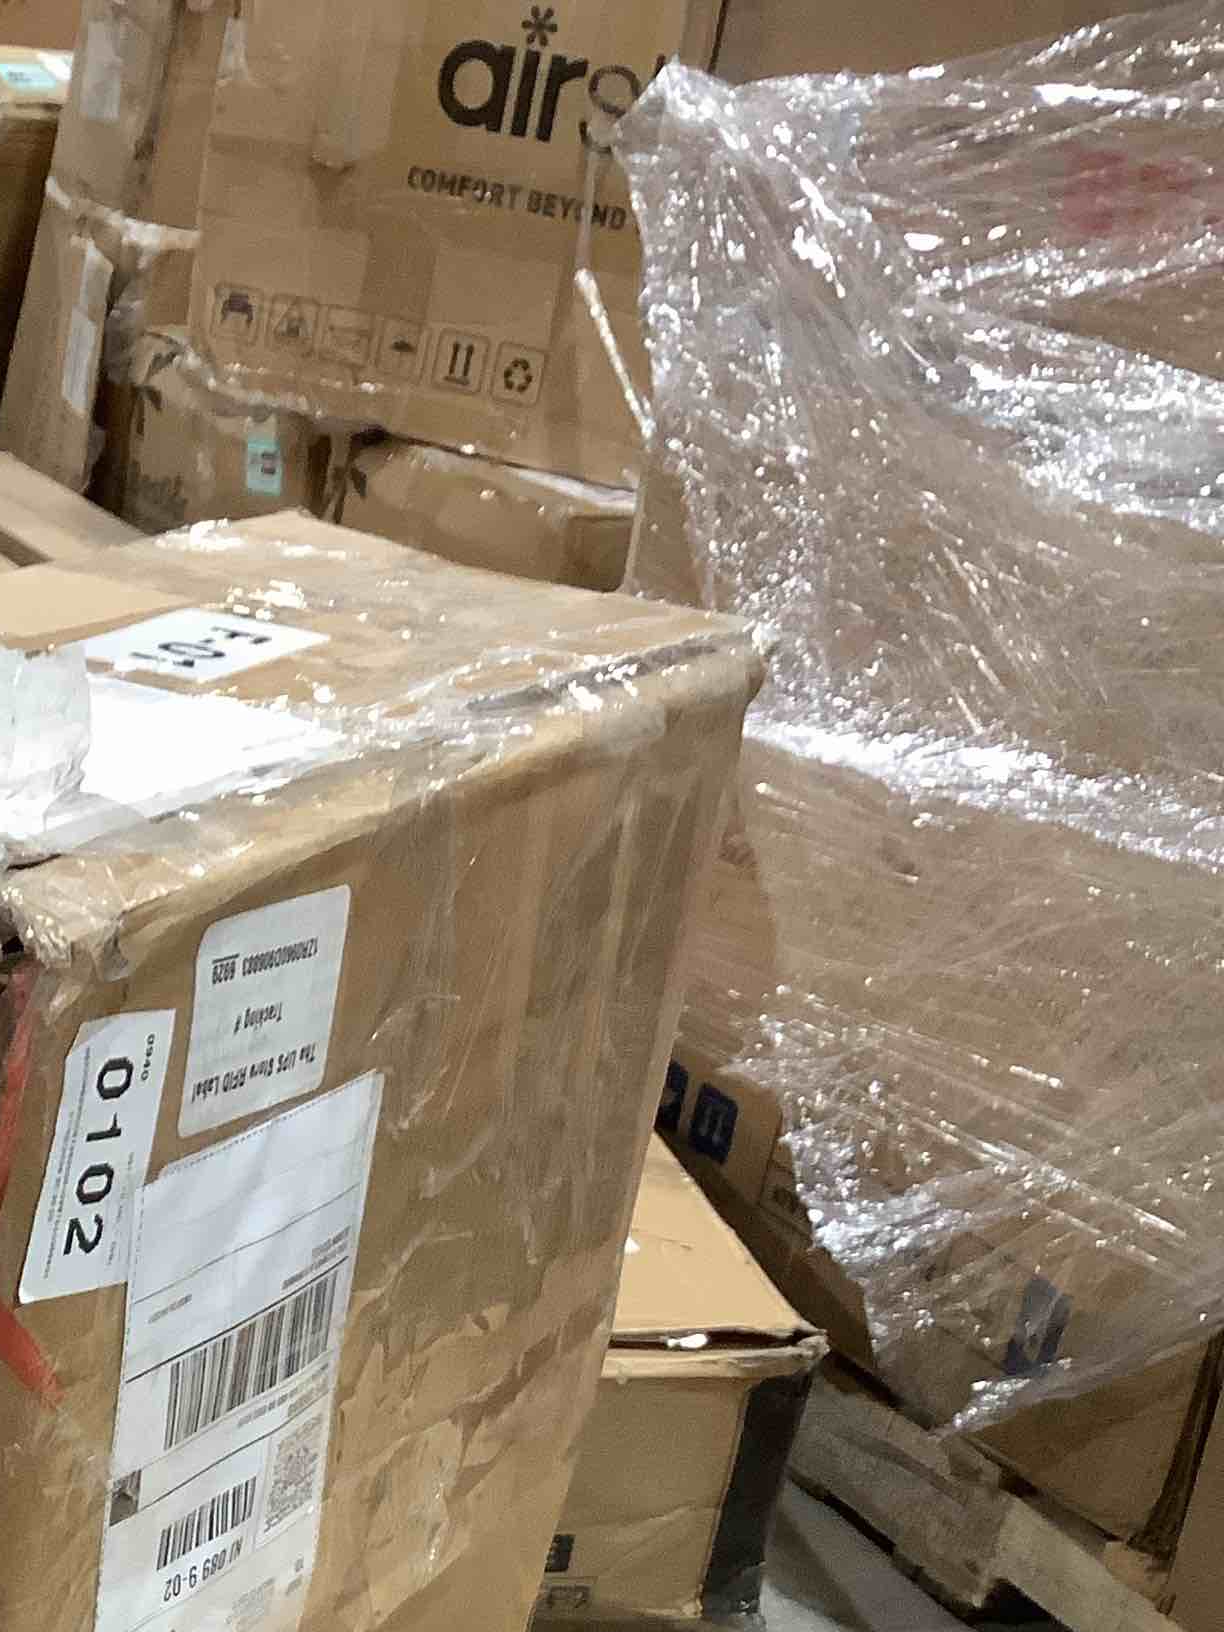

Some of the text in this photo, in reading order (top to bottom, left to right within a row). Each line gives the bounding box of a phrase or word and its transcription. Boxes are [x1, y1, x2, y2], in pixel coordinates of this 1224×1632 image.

[408, 167, 523, 207] COMFORT
[244, 1002, 283, 1031] Tracking
[192, 1042, 316, 1103] The UPS Store RFID Label
[63, 1057, 134, 1256] 0102
[163, 1565, 197, 1602] 9-02
